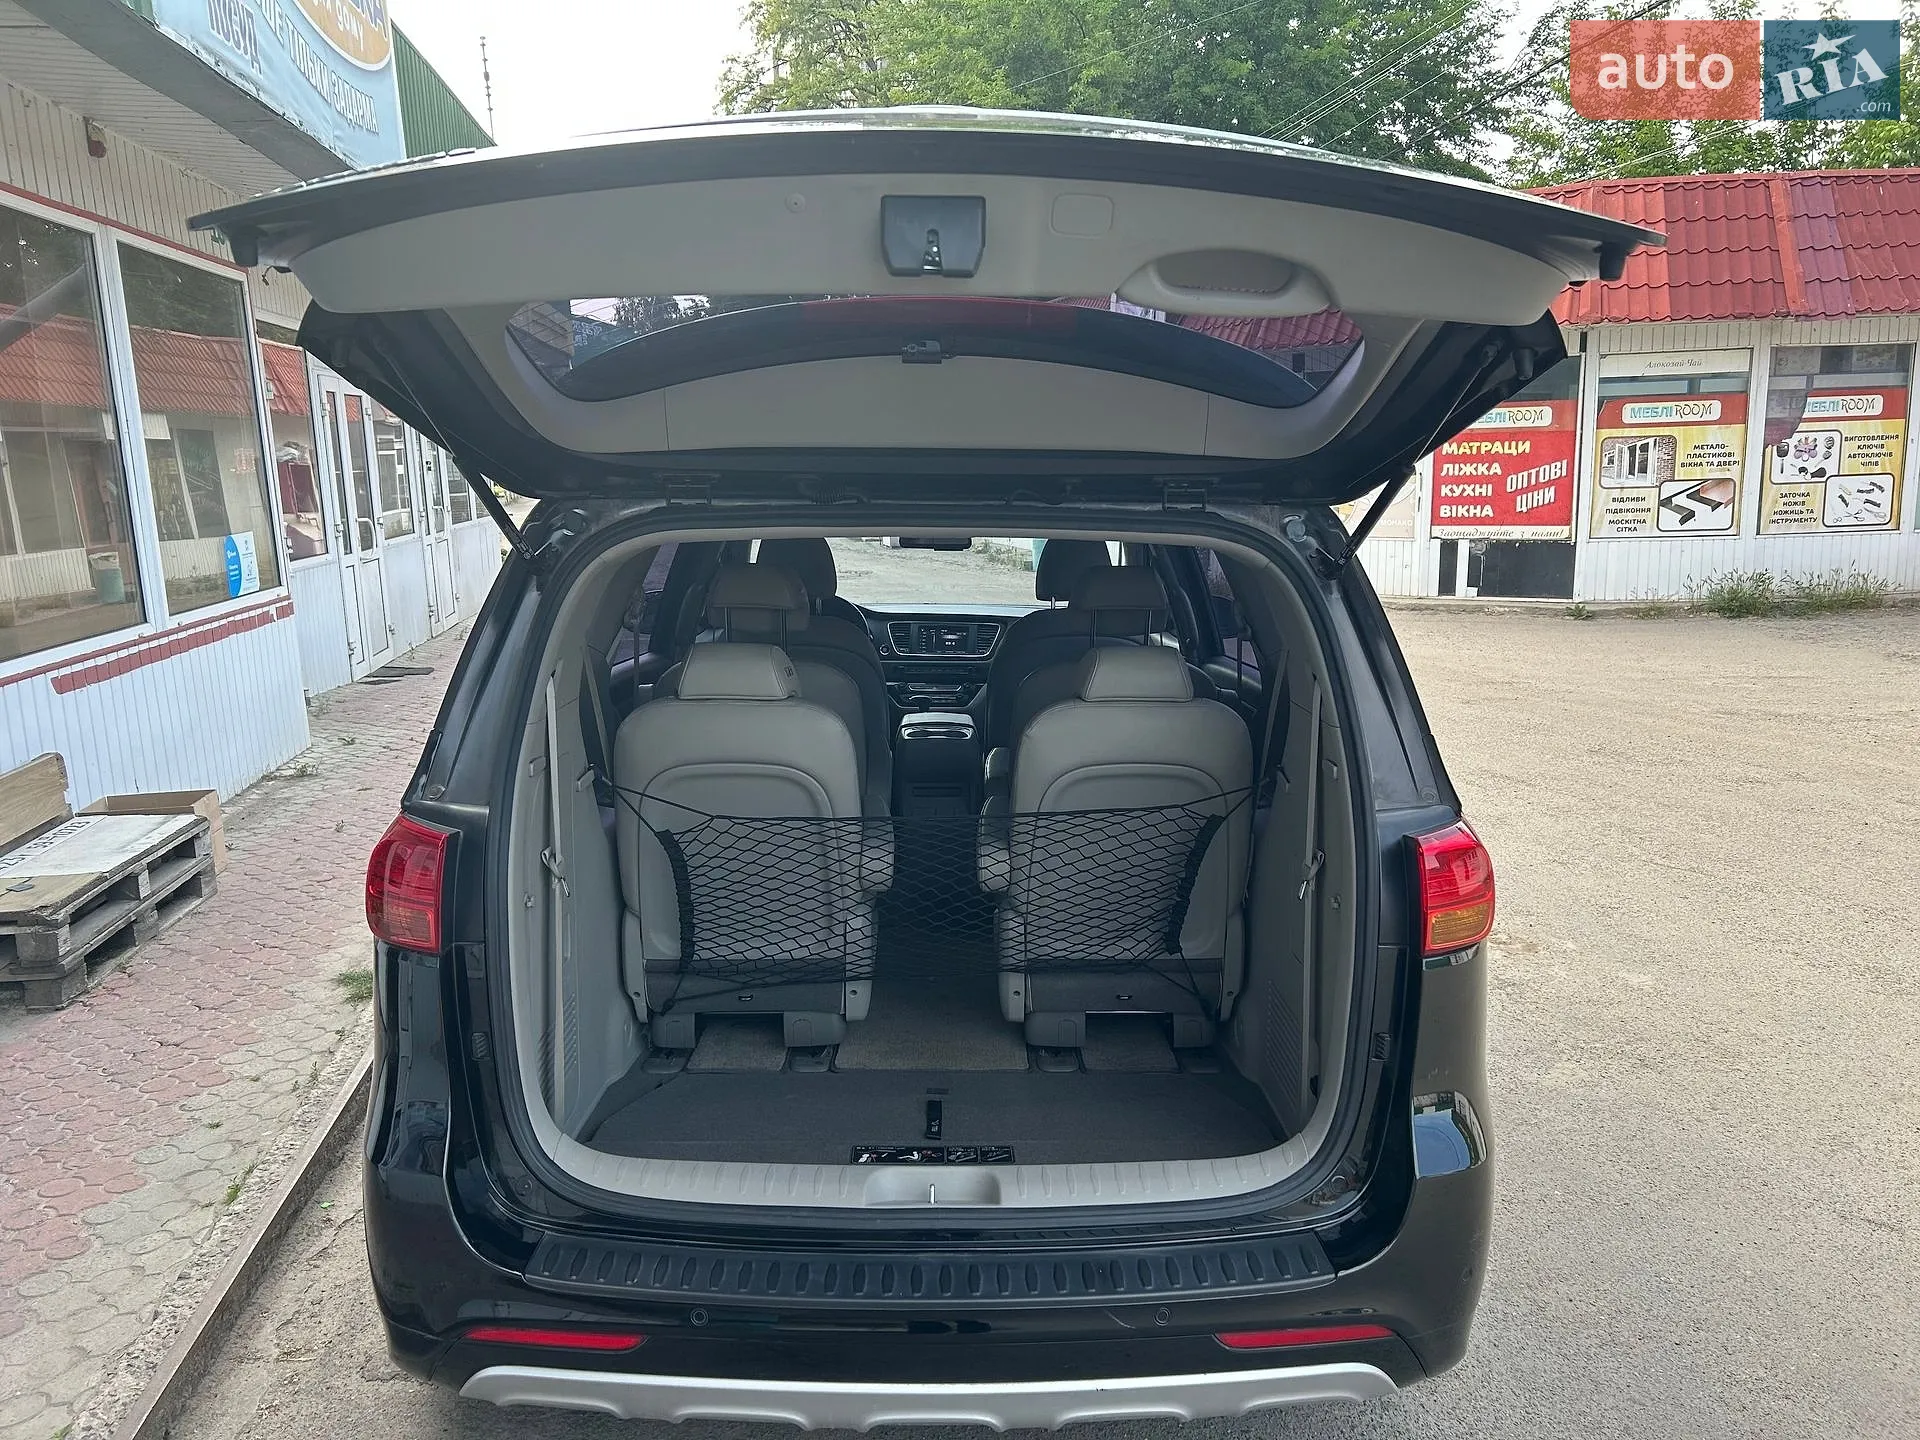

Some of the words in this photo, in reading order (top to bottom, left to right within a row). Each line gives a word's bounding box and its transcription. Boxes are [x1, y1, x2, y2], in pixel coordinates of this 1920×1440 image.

[331, 69, 379, 136] ЗАДАРМА
[1844, 434, 1900, 443] ВИГОТОВЛЕННЯ
[1441, 440, 1531, 456] МАТРАЦИ
[1693, 443, 1729, 451] МЕТАЛО-
[1857, 443, 1885, 451] КЛЮЧІВ
[1686, 452, 1735, 460] ПЛАСТИКОВІ
[1847, 451, 1894, 460] АВТОКЛЮЧІВ
[1680, 461, 1704, 469] ВІКНА
[1716, 460, 1740, 468] ДВЕРІ
[1860, 460, 1880, 468] ЧІПІВ
[1440, 462, 1502, 477] ЛІЖКА
[1506, 459, 1568, 494] ОПТОВІ
[1440, 484, 1493, 498] КУХНІ
[1515, 486, 1556, 513] ЦІНИ
[1611, 496, 1646, 504] ВІДЛИВИ
[1439, 504, 1494, 518] ВІКНА
[1605, 507, 1651, 516] ПІДВІКОННЯ
[1773, 509, 1804, 517] НОЖИЦЬ
[1608, 518, 1647, 526] МОСКІТНА
[1769, 516, 1817, 525] ІНСТРУМЕНТУ
[1531, 529, 1564, 538] нами!
